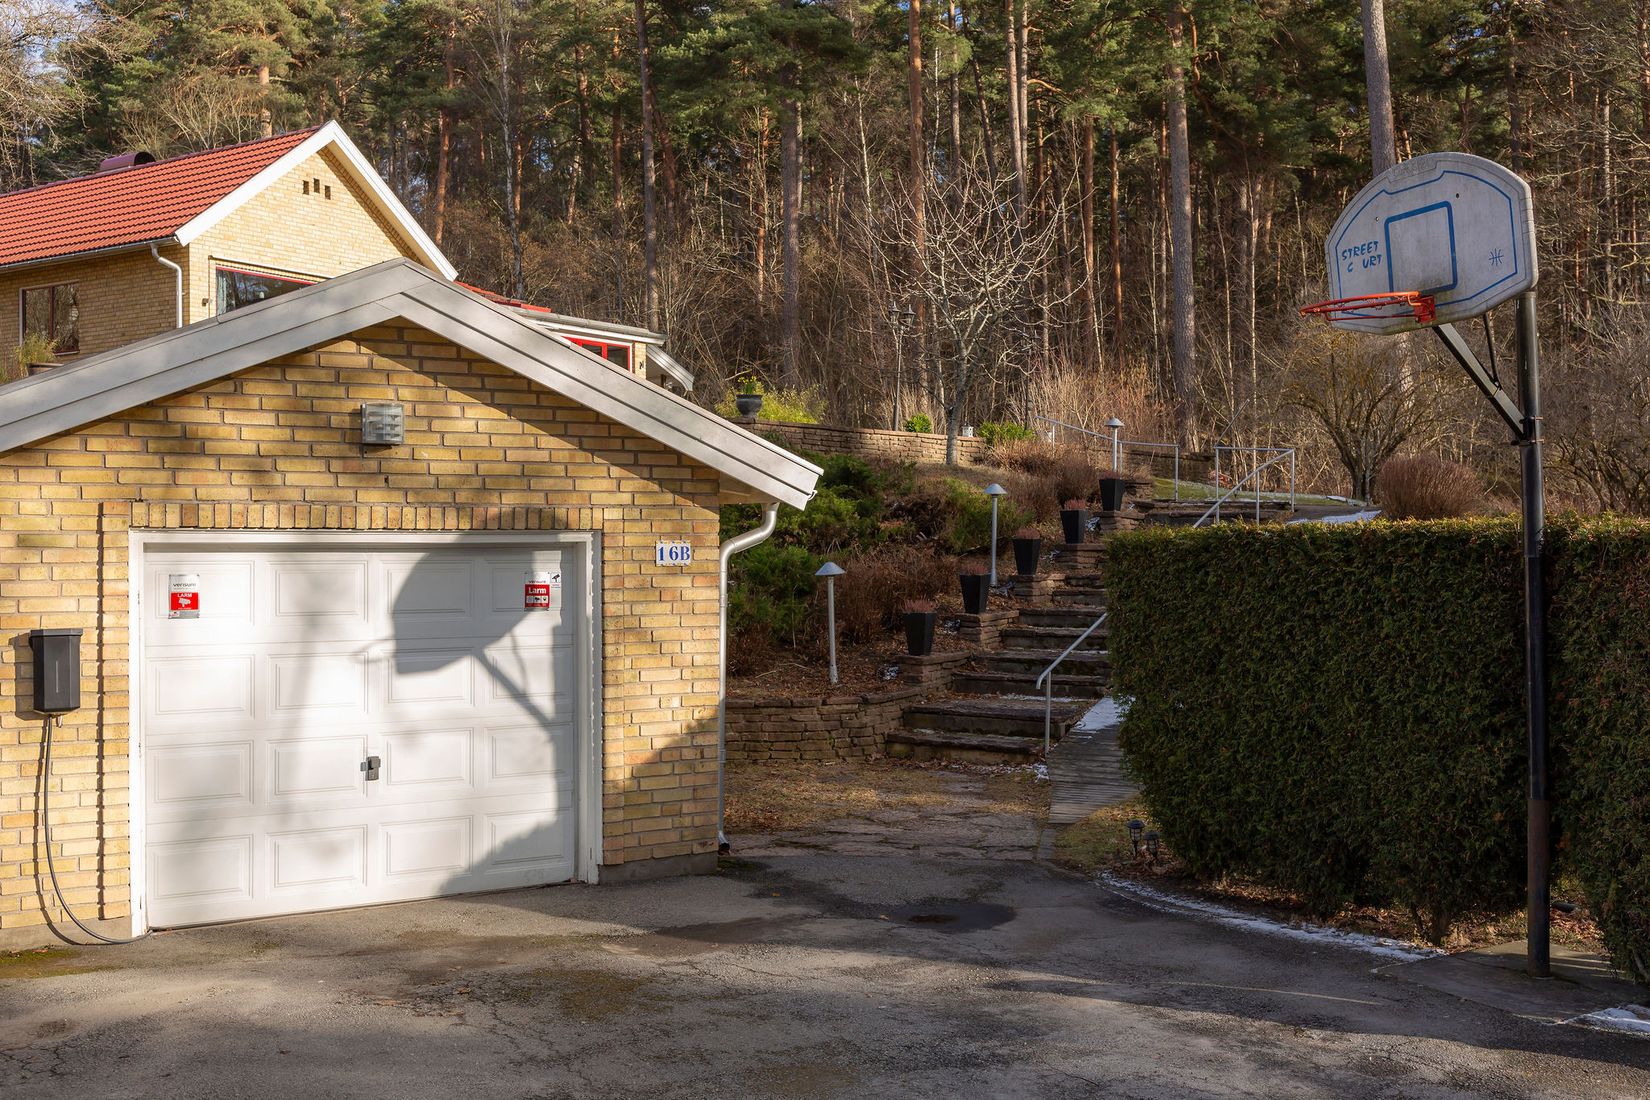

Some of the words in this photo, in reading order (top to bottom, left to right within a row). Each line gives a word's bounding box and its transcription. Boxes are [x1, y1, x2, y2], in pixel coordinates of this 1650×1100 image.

[1342, 240, 1379, 261] STREET
[1347, 254, 1382, 272] CURT
[658, 545, 690, 561] 16B
[528, 586, 547, 594] Larm
